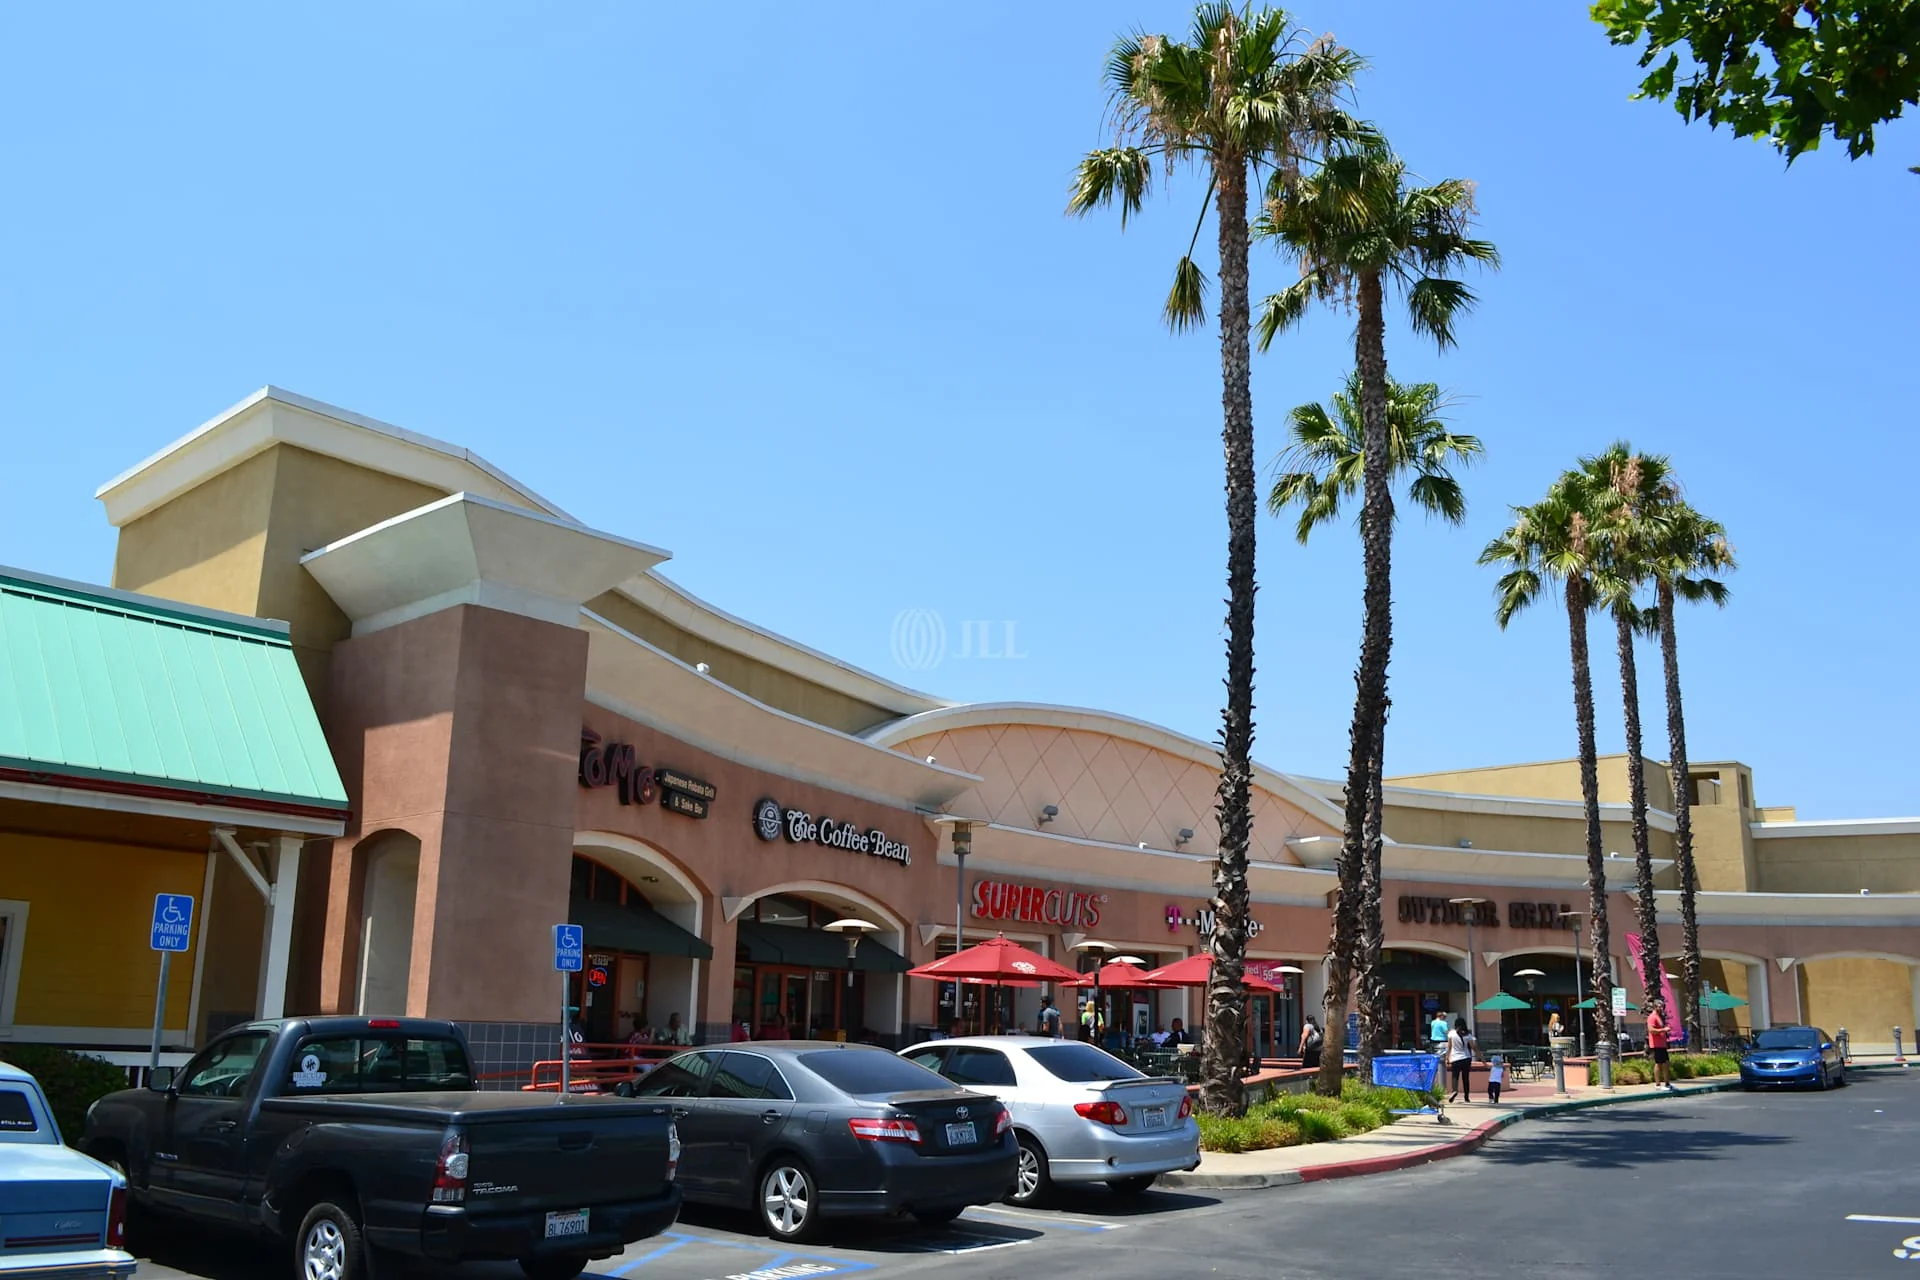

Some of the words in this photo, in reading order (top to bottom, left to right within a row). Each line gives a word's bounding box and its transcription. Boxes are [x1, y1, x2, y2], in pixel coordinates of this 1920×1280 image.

[786, 809, 818, 842] The
[819, 817, 869, 853] Coffee
[870, 829, 912, 866] Bean
[153, 922, 189, 936] PARKING
[159, 935, 181, 948] ONLY
[556, 947, 581, 958] PARKING
[561, 957, 576, 968] ONLY
[472, 1185, 519, 1195] TACOMA
